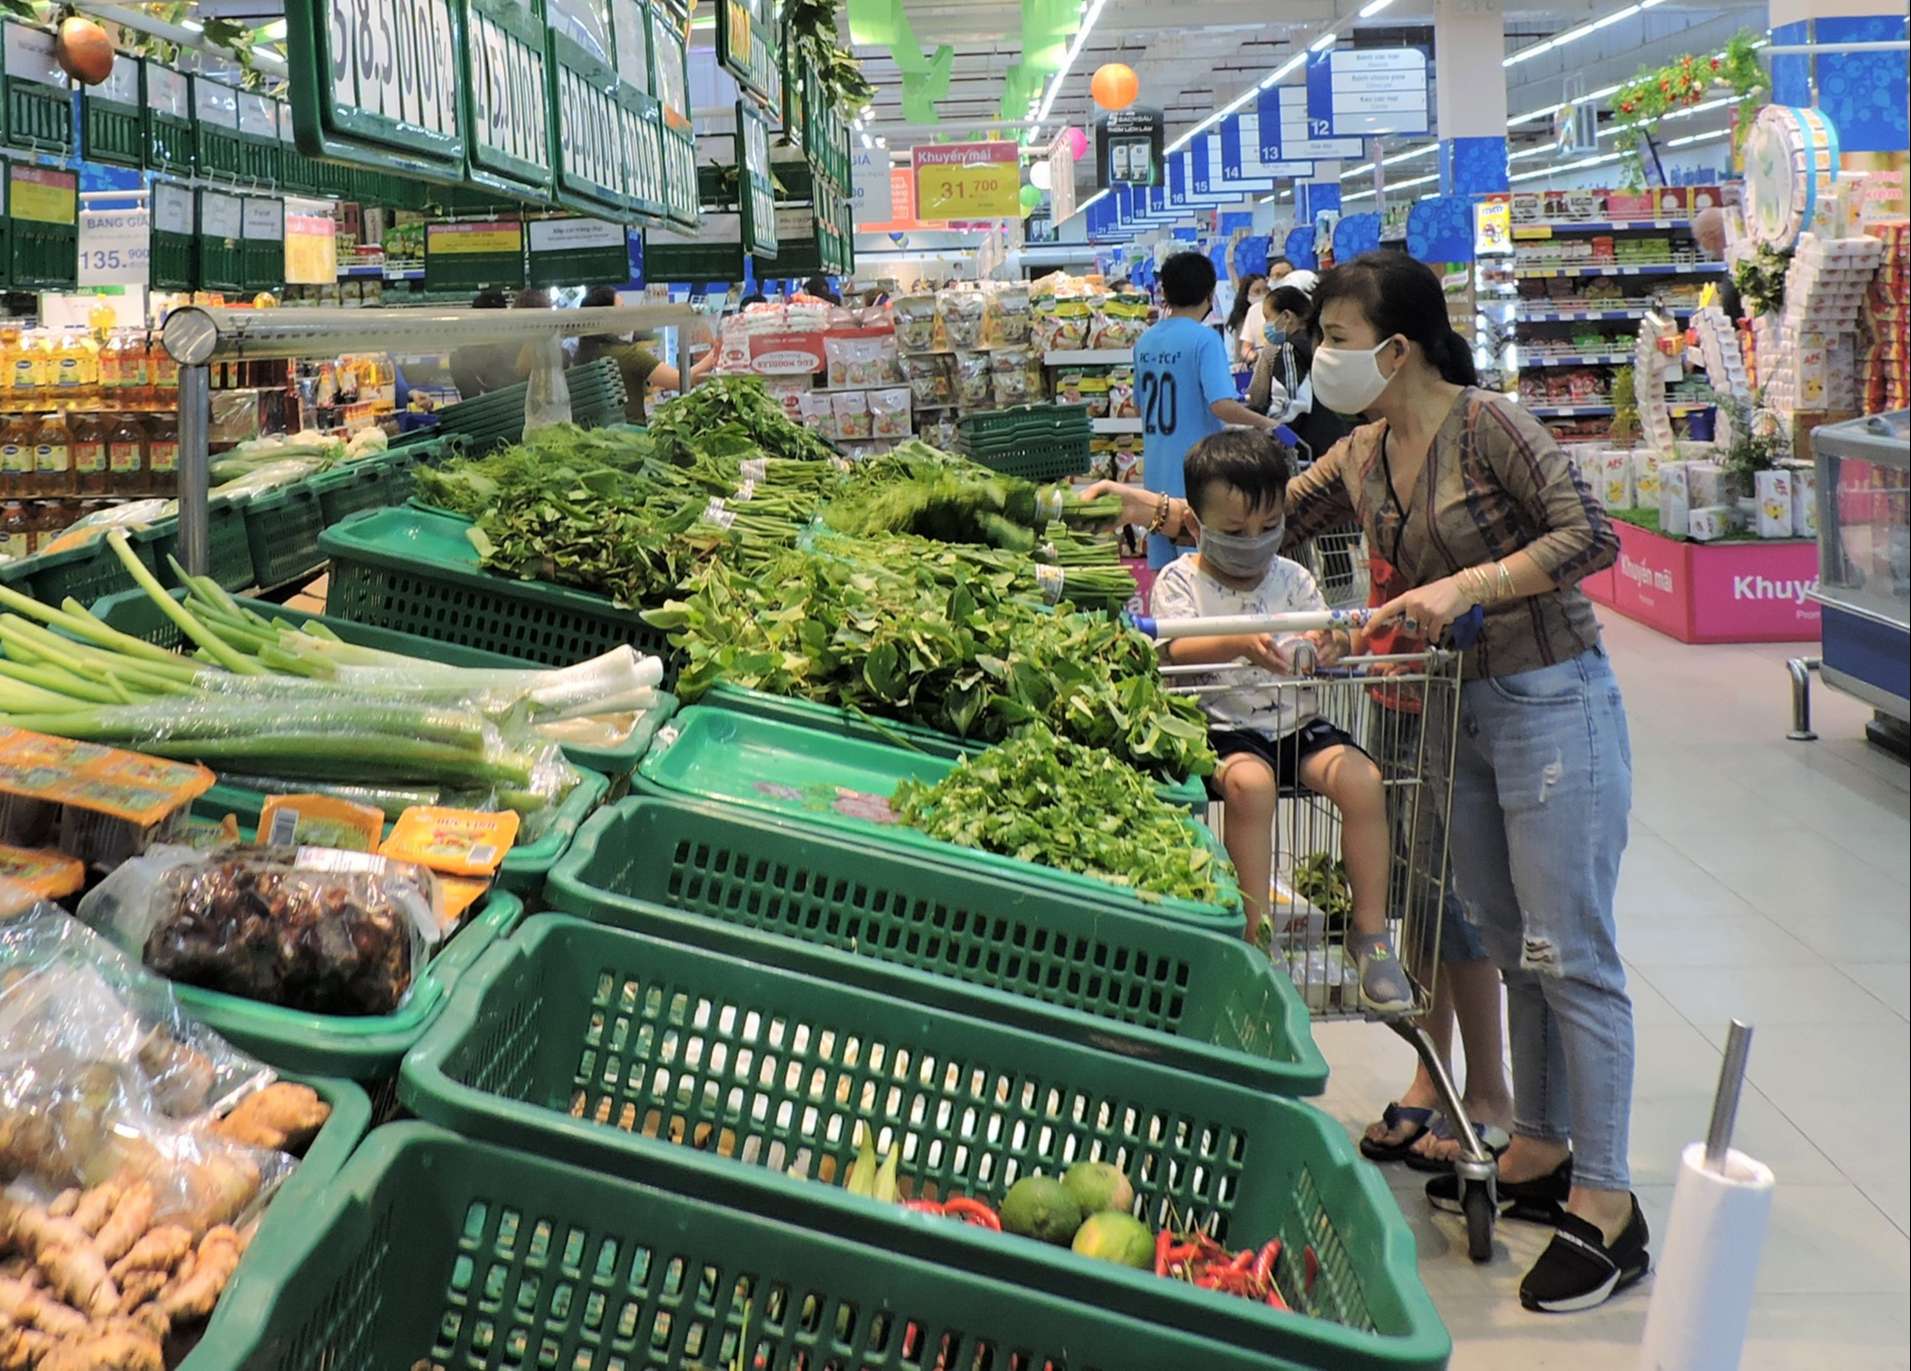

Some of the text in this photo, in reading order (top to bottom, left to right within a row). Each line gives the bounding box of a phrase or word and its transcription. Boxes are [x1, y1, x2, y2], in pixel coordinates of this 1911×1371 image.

[1311, 120, 1330, 136] 12
[1262, 147, 1279, 160] 13
[1224, 166, 1239, 179] 14
[1195, 181, 1208, 192] 15
[1172, 194, 1184, 203] 16
[1152, 201, 1163, 211] 17
[1142, 371, 1177, 436] 20
[1621, 555, 1653, 587] Khuyến
